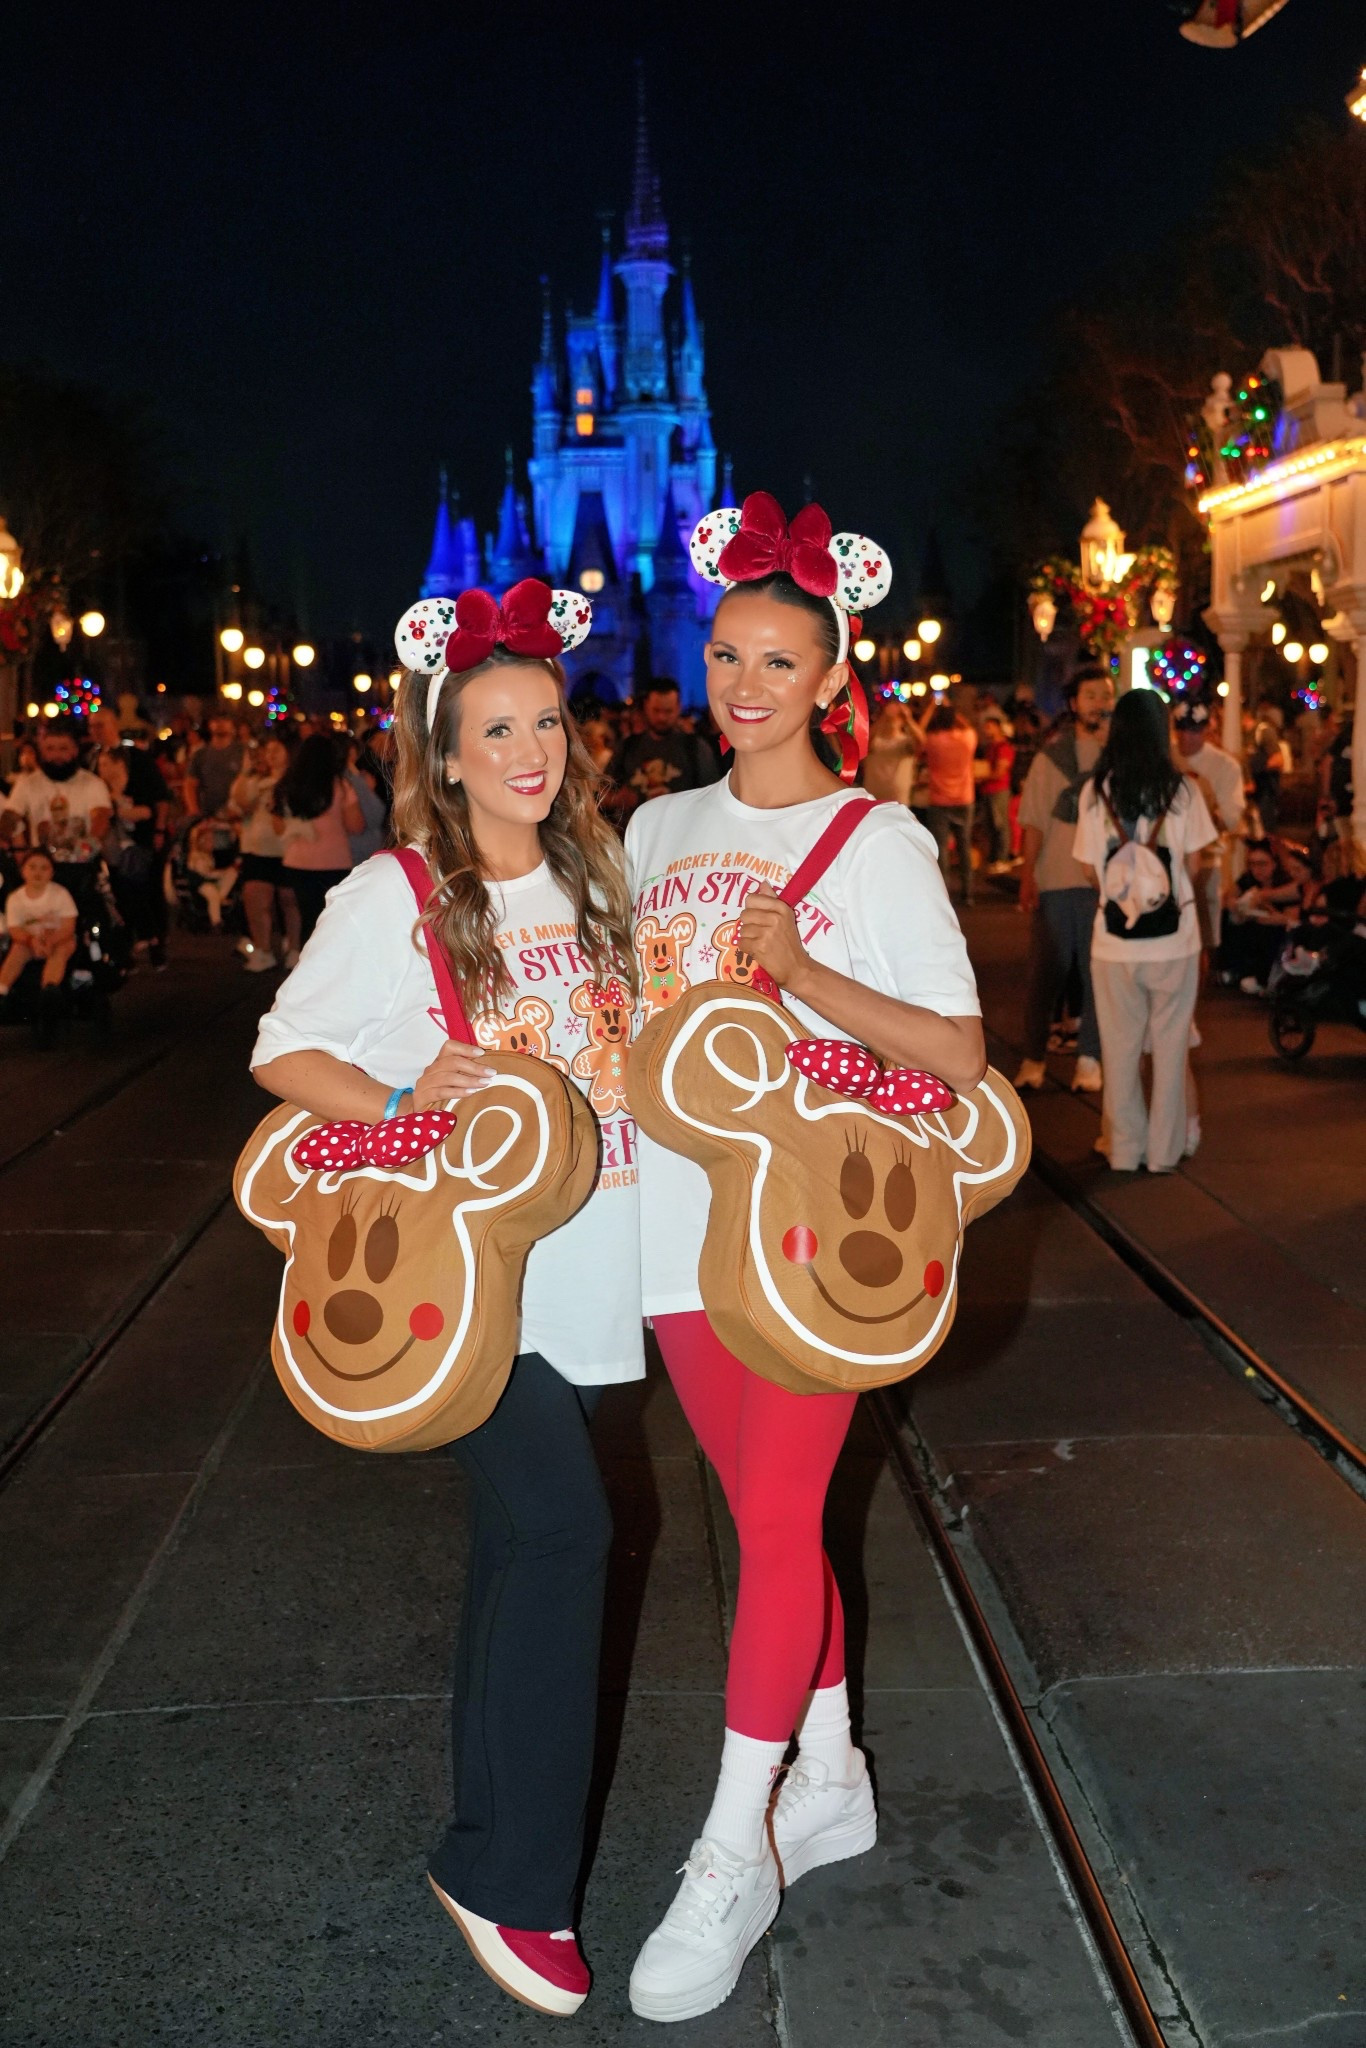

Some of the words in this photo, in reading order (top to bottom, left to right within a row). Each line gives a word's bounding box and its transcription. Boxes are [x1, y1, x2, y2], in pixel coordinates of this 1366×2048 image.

[666, 852, 719, 876] MICKEY
[721, 853, 732, 868] &
[698, 871, 834, 946] STRT
[519, 927, 533, 945] &
